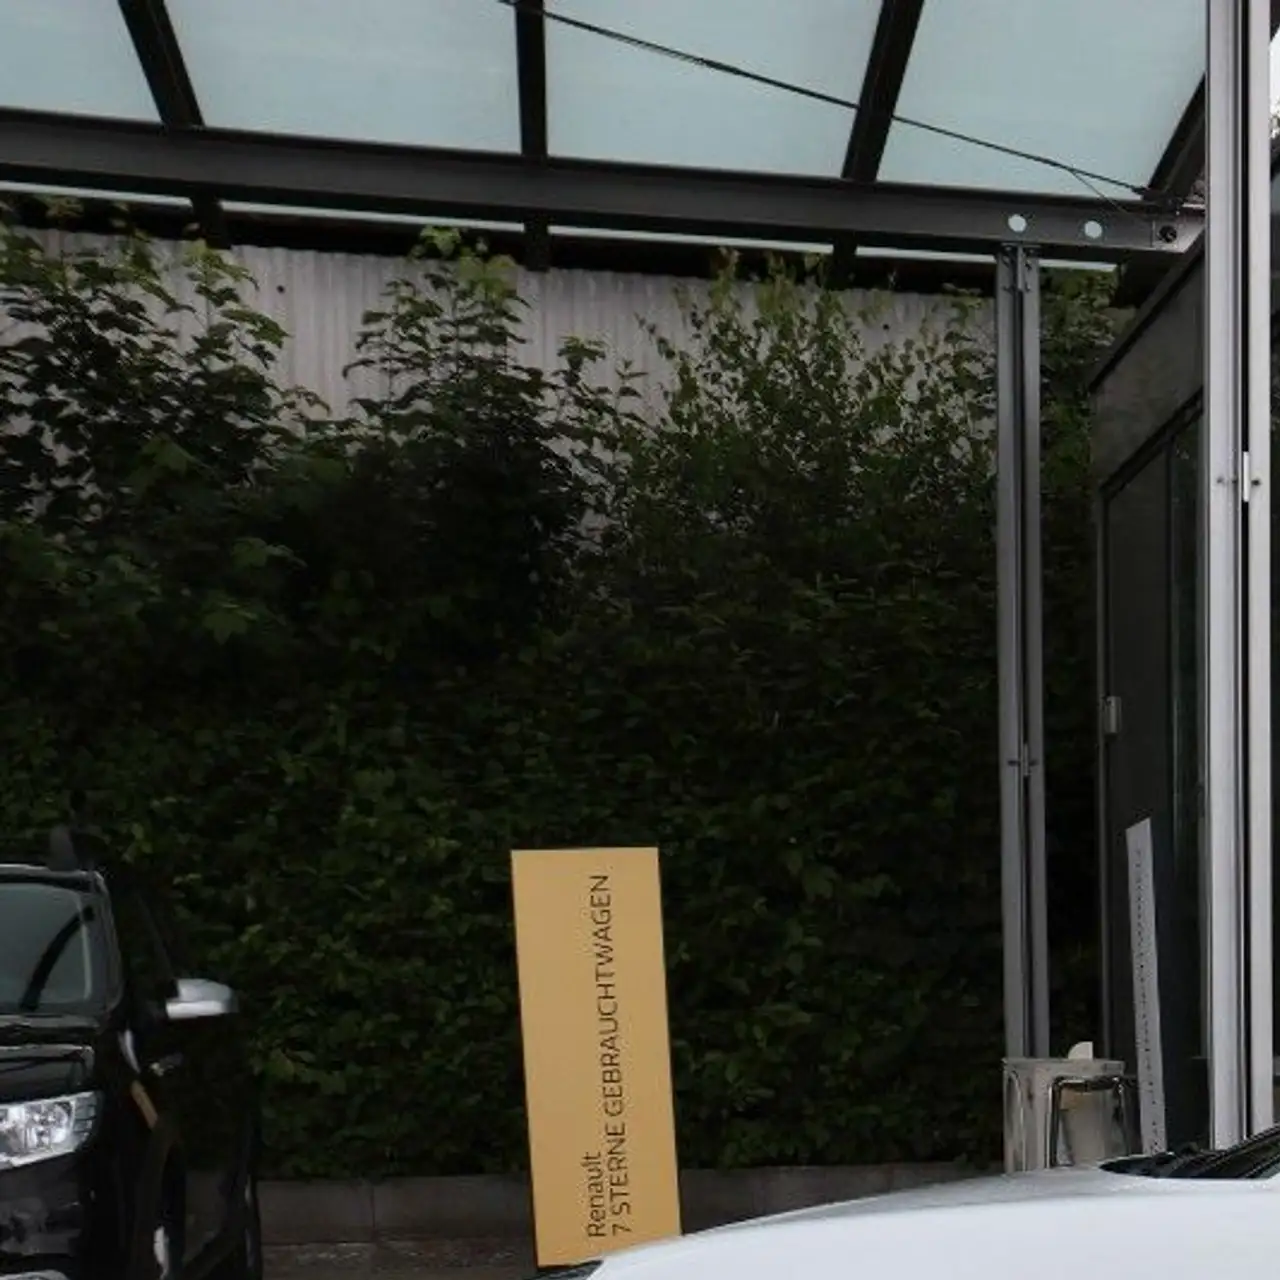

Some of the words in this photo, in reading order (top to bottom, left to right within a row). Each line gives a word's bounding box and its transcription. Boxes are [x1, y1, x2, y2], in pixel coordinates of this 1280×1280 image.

[590, 874, 625, 1117] GEBRAUCHTWAGEN
[582, 1151, 607, 1238] Renault
[604, 1121, 632, 1216] STERNE
[612, 1223, 633, 1237] 7
